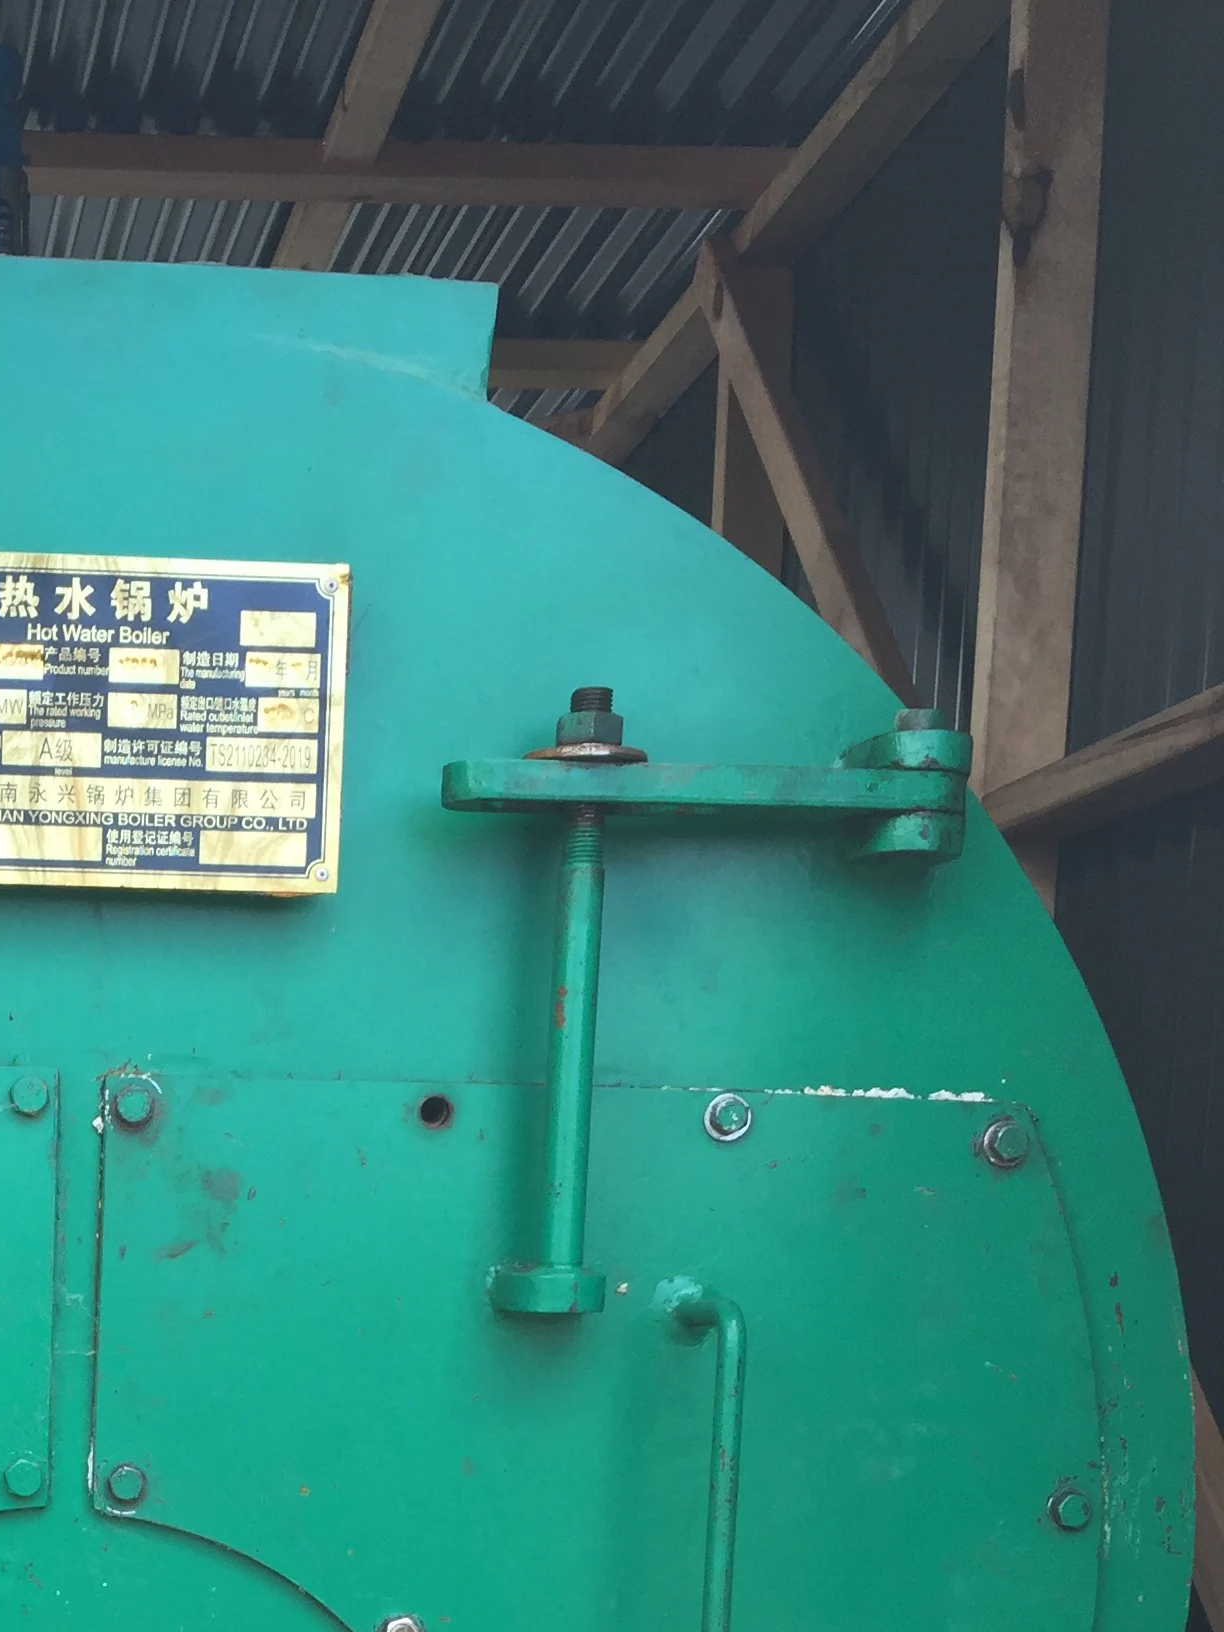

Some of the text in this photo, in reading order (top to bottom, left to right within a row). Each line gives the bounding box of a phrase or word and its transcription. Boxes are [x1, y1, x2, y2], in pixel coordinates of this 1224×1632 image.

[27, 623, 170, 645] Hot Water Boiler
[44, 647, 101, 663] 产品编号
[183, 651, 239, 667] 制造日期
[44, 664, 109, 676] Product number
[181, 667, 245, 682] The manufacturing
[276, 660, 287, 680] 年
[306, 661, 317, 680] 月
[29, 690, 104, 707] 额定工作压力
[29, 705, 101, 720] The rated working
[148, 703, 174, 720] MPa
[181, 711, 206, 722] Rated
[30, 718, 66, 729] pressure
[180, 723, 259, 735] water temperature
[39, 738, 73, 762] A级
[104, 739, 202, 756] 制造许可证编号
[104, 755, 203, 767] manufacture license No.
[55, 767, 73, 776] level
[28, 810, 113, 825] YONGXING
[118, 813, 176, 828] BOILER
[180, 815, 237, 829] GROUP
[241, 816, 274, 831] CO.,
[278, 817, 308, 831] LTD
[106, 830, 194, 846] 使用登记证编号
[105, 843, 154, 857] Registration
[105, 856, 137, 867] number
